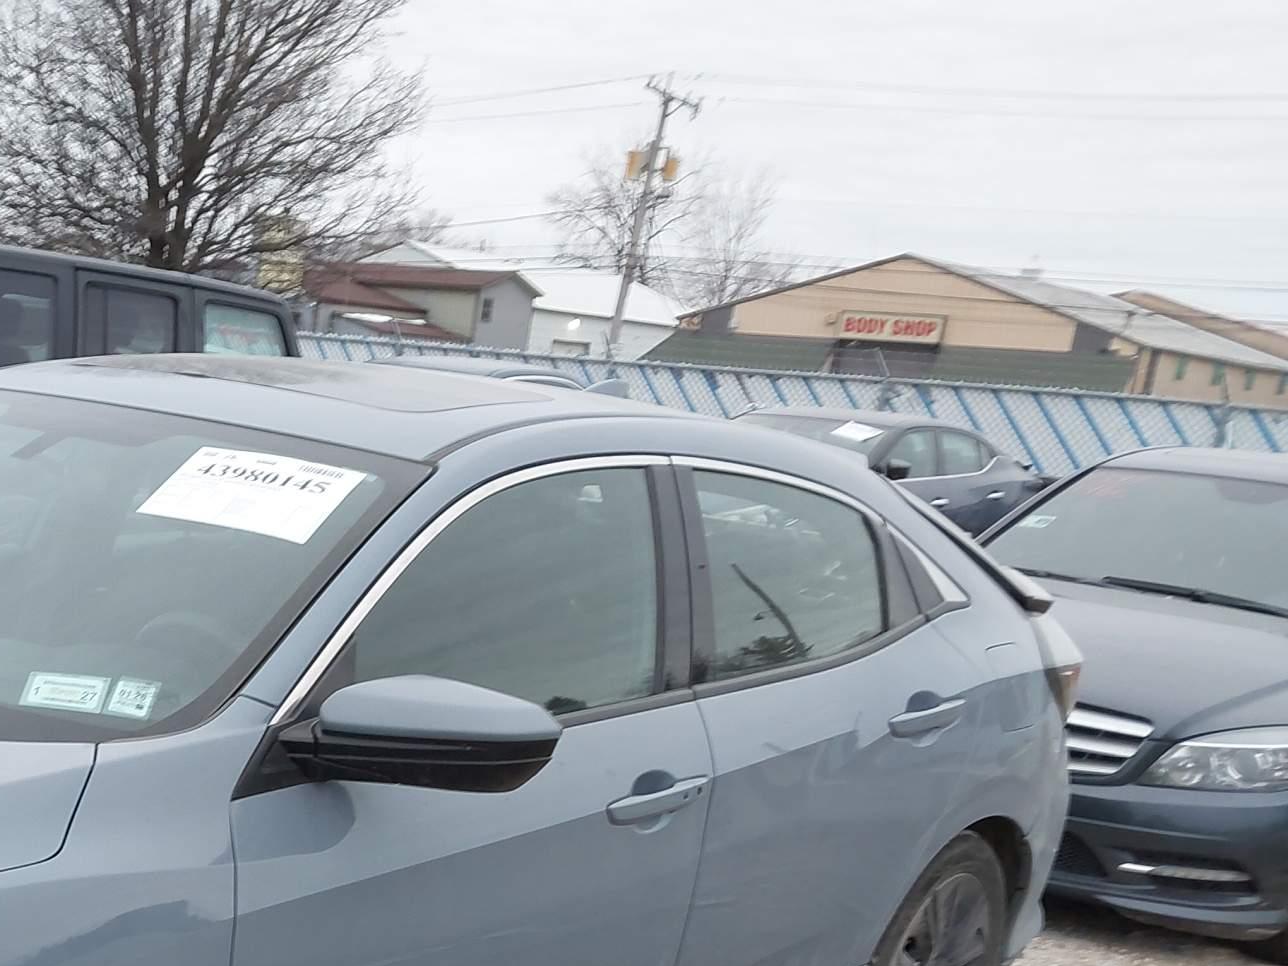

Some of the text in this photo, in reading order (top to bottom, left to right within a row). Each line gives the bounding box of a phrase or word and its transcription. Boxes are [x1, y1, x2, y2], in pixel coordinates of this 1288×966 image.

[843, 316, 937, 337] BODY SHOP
[197, 462, 332, 495] 43980145
